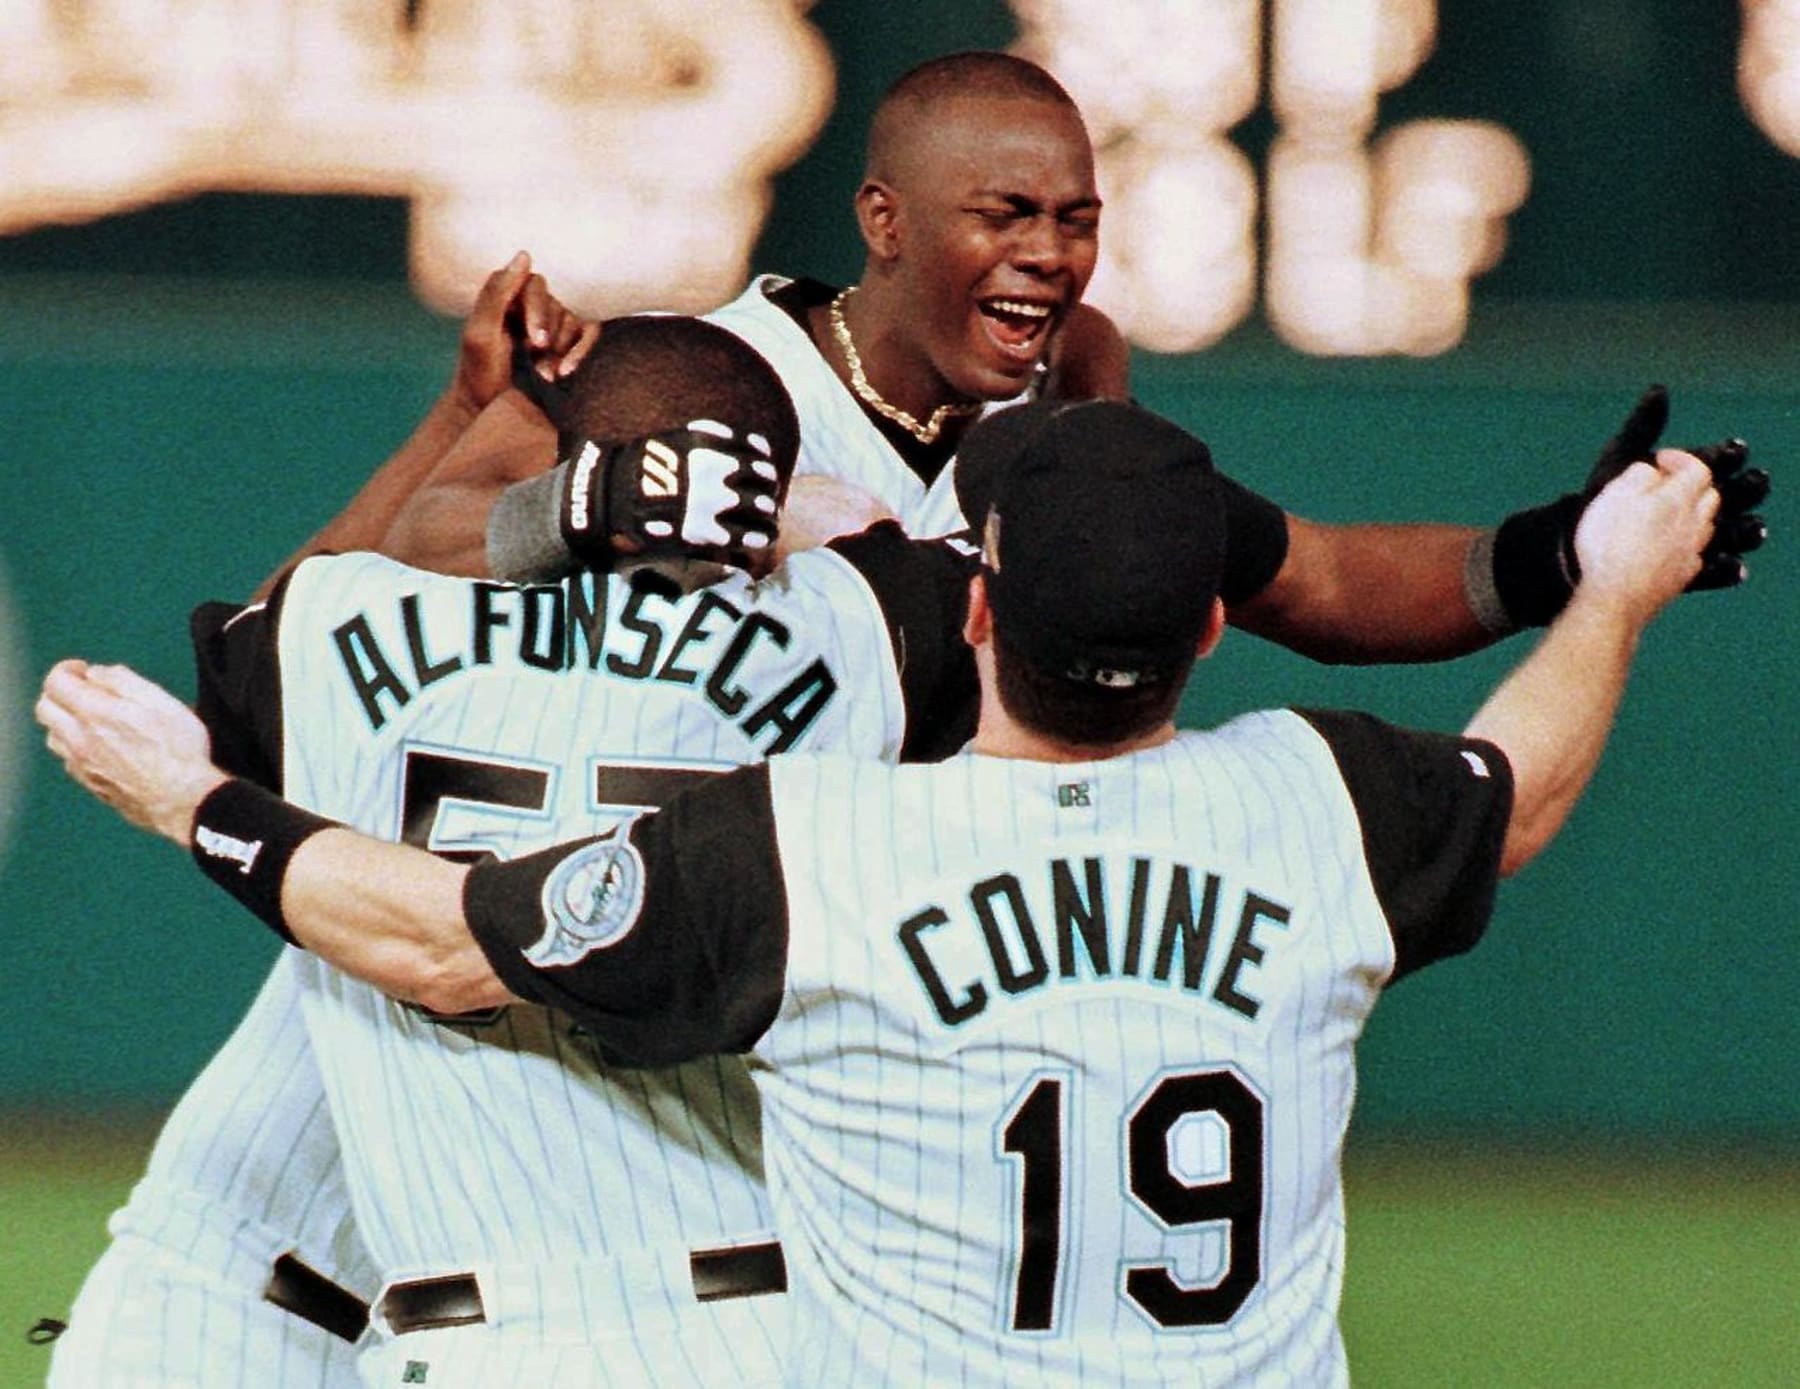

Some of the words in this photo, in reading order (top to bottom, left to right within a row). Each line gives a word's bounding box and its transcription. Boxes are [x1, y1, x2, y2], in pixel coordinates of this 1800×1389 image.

[333, 572, 838, 757] ALFONSECA
[897, 857, 1292, 1026] CONINE
[1000, 1069, 1266, 1332] 19
